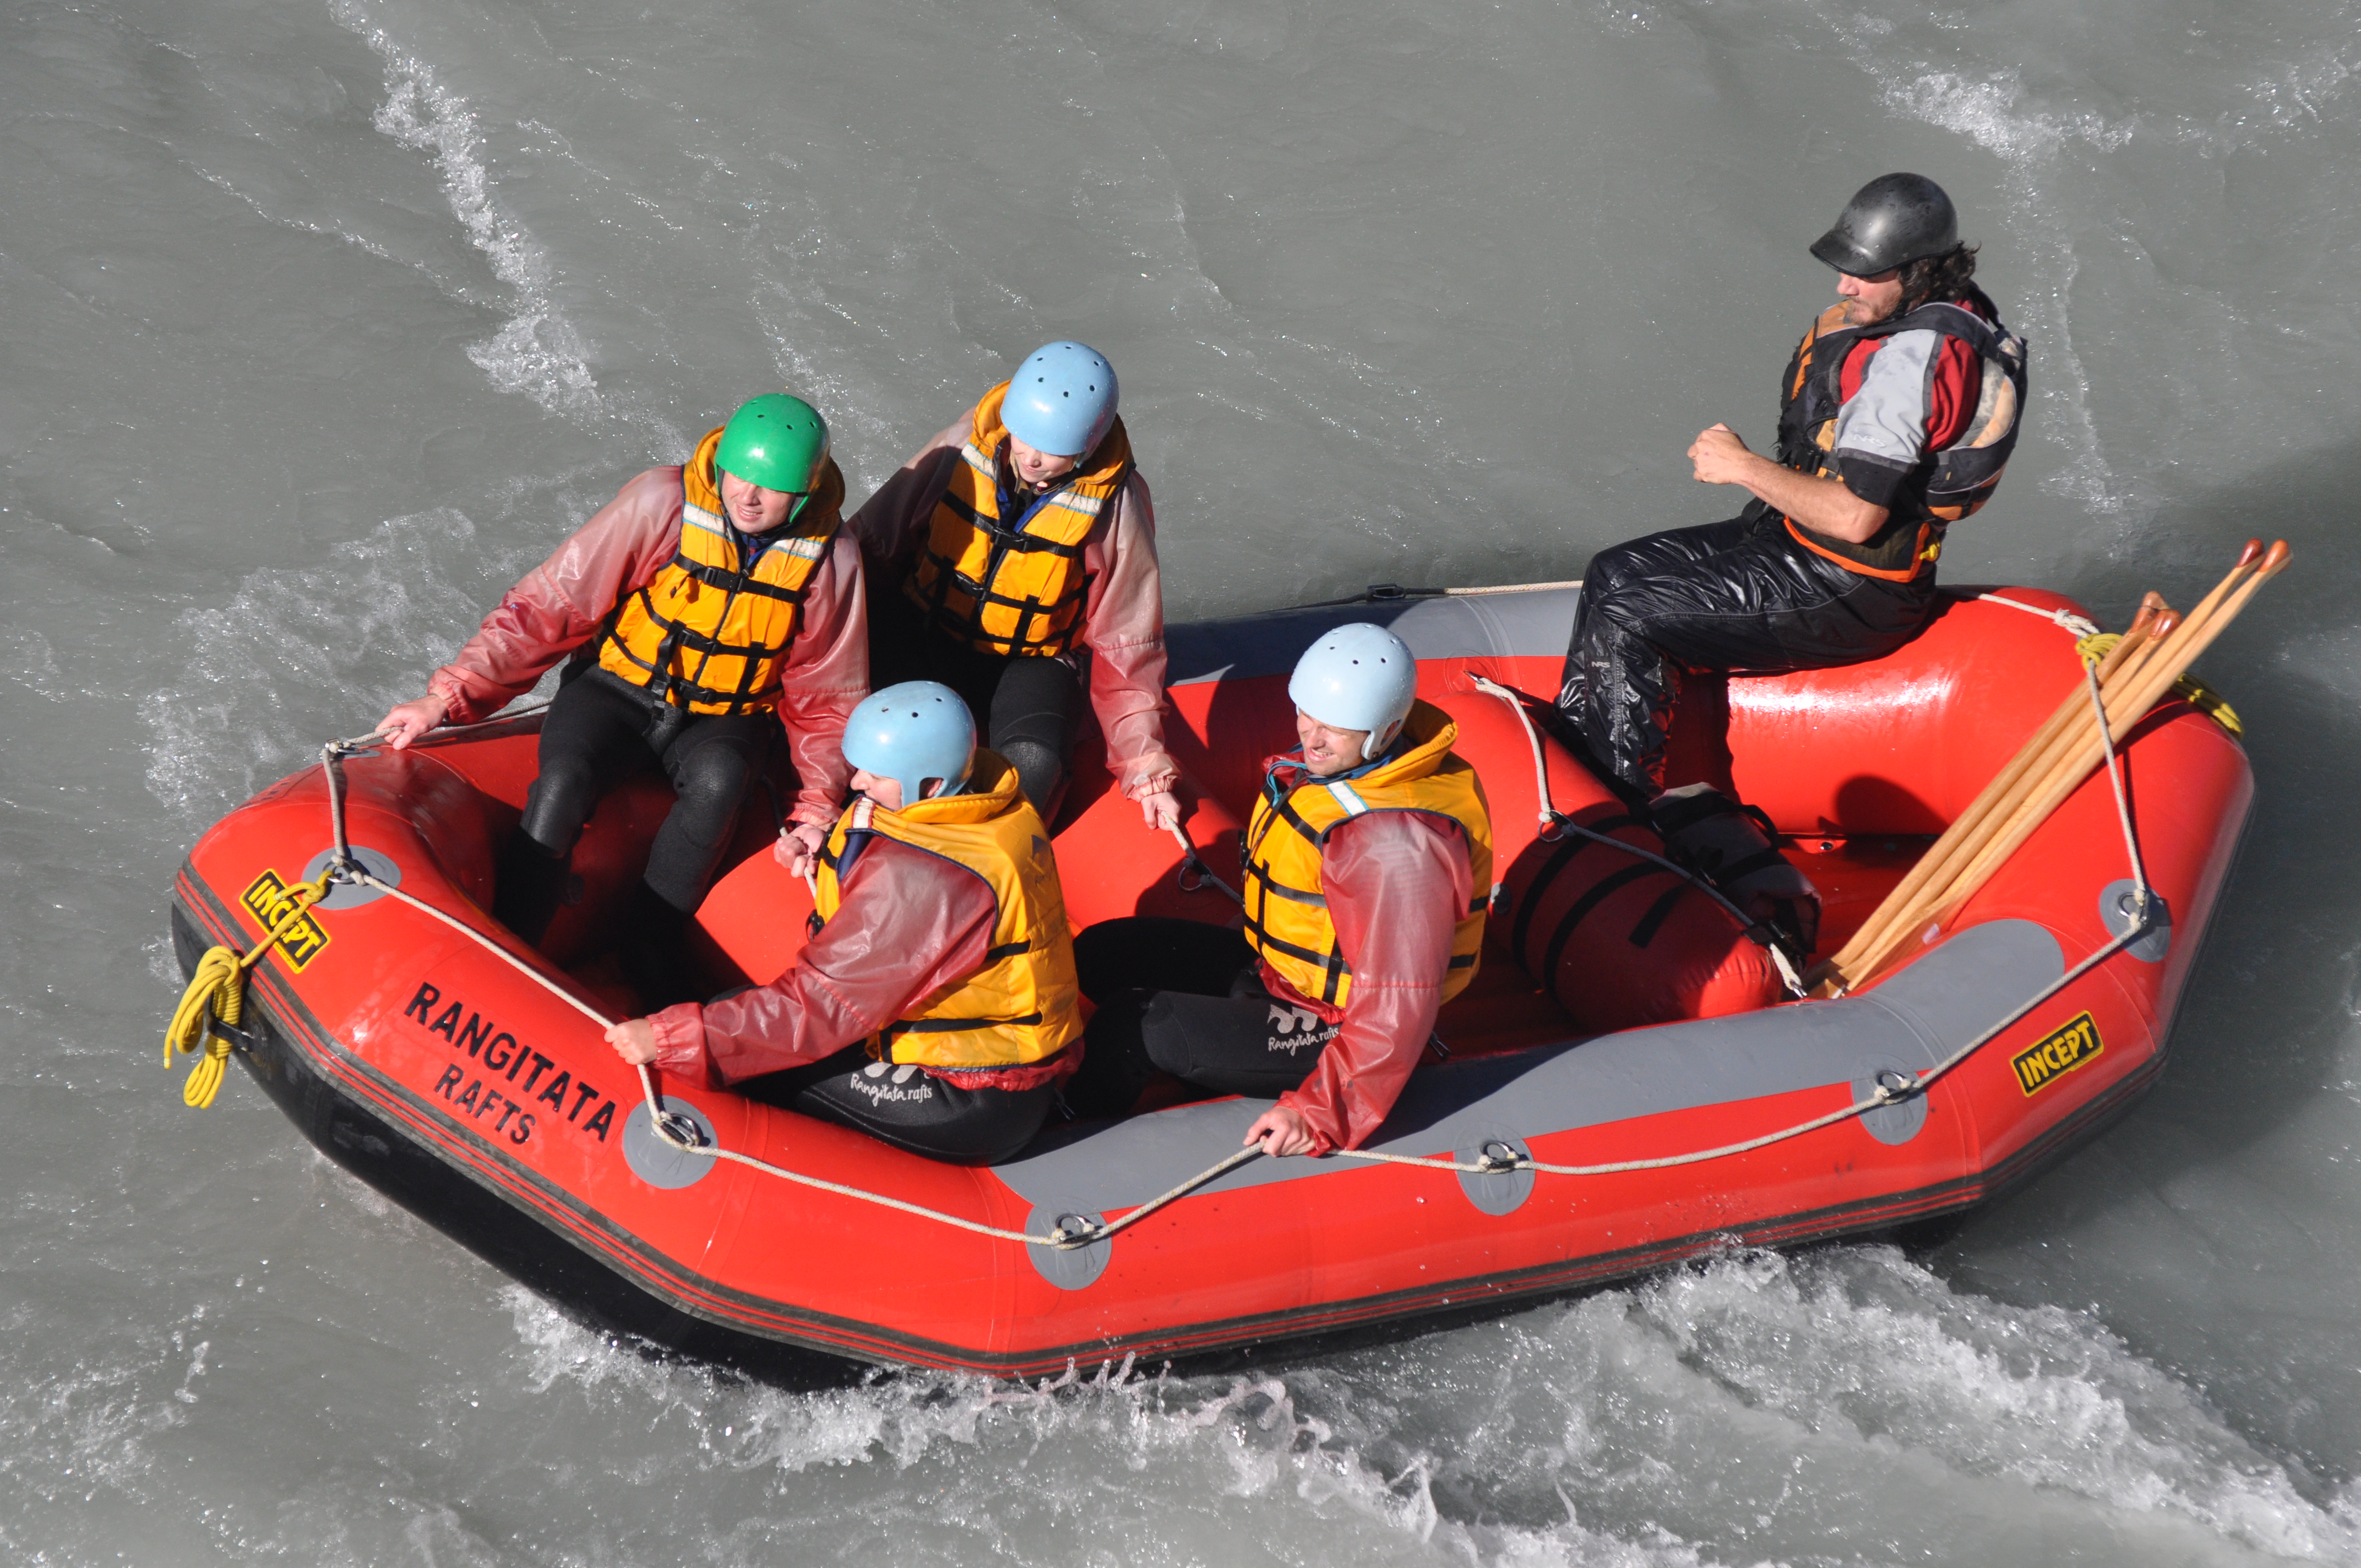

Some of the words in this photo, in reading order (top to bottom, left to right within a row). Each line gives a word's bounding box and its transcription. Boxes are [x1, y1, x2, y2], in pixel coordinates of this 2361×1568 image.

[1853, 433, 1887, 448] NRS
[404, 981, 616, 1143] RANGITATA
[1267, 1033, 1319, 1057] Rangitata
[2019, 1020, 2094, 1088] INCEPT
[433, 1063, 536, 1145] RAFTS
[850, 1073, 907, 1107] Rangitata
[907, 1084, 932, 1103] rafts
